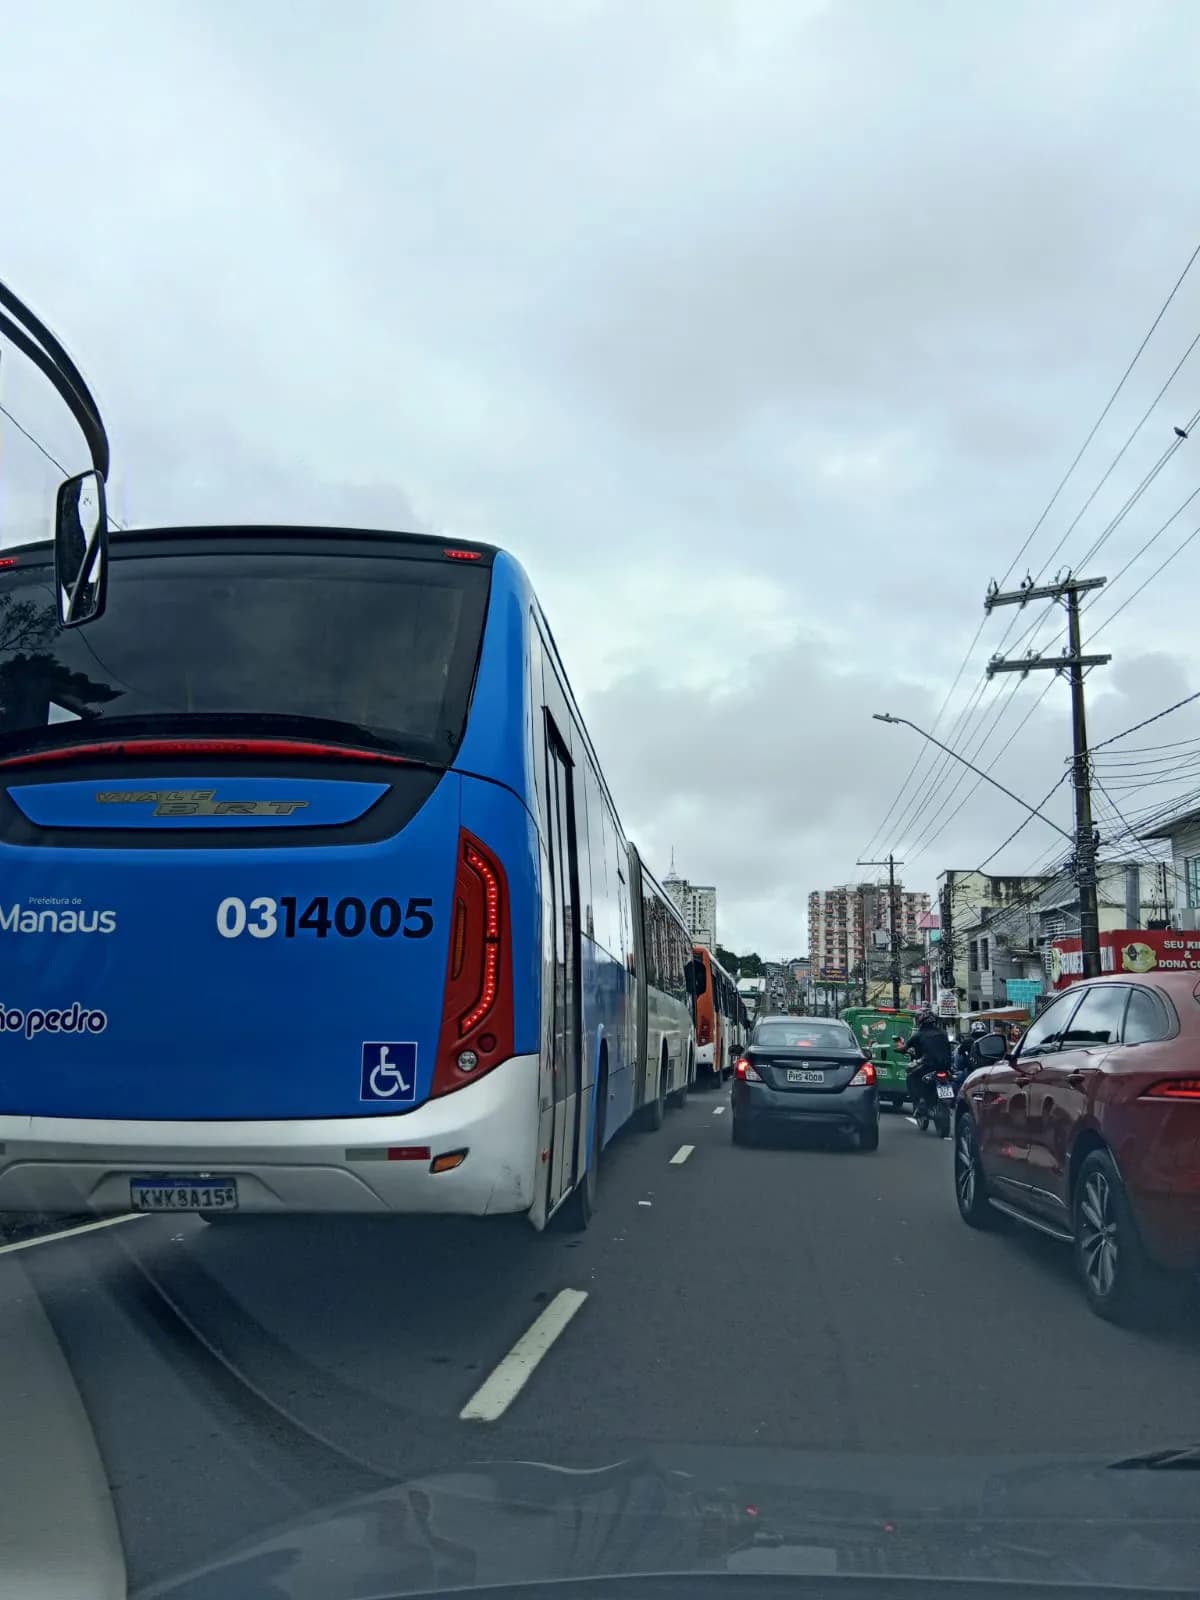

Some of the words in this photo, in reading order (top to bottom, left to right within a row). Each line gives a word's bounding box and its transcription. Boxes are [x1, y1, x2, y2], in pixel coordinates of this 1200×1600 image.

[154, 802, 308, 816] BRT
[29, 897, 69, 905] Prefeitura
[72, 897, 82, 905] de
[0, 903, 117, 933] Manaus
[216, 896, 434, 939] 0314005
[1164, 940, 1184, 949] SEU
[1184, 951, 1192, 959] &
[1159, 960, 1187, 968] DONA
[25, 1001, 107, 1040] pedro
